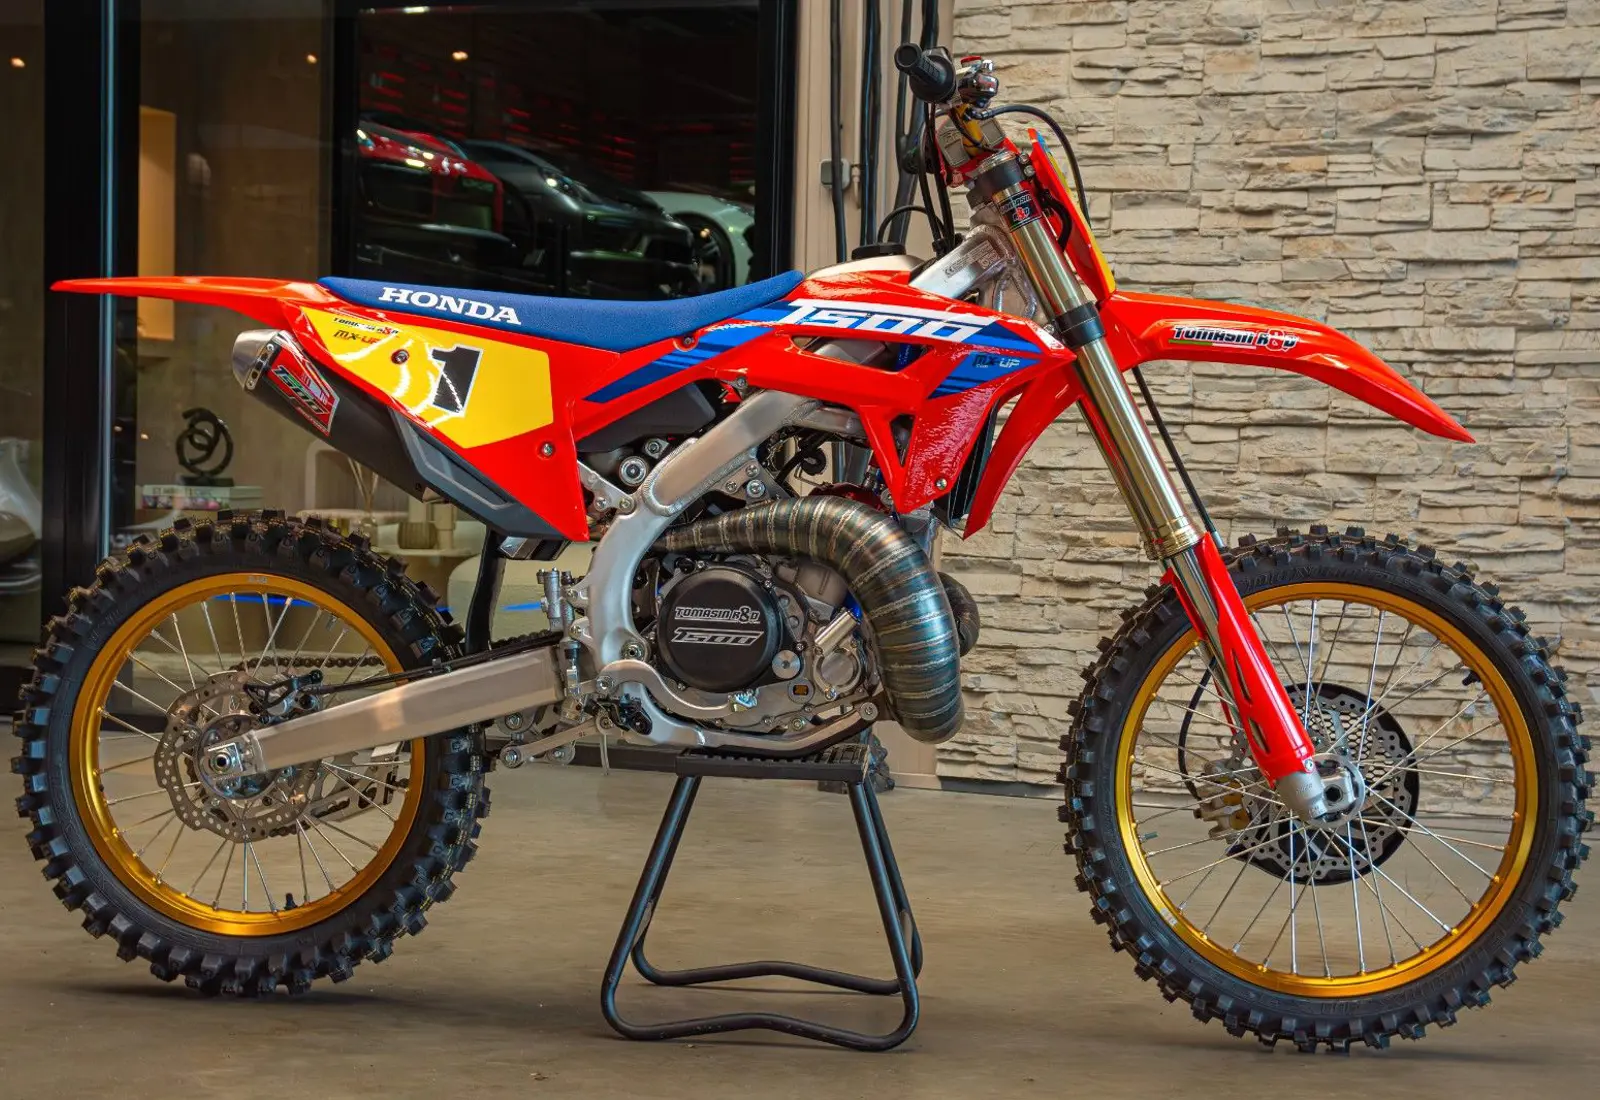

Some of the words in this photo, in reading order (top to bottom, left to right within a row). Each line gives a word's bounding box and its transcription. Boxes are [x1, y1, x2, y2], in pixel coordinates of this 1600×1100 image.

[379, 287, 521, 325] HONDA
[1172, 326, 1256, 345] TOMASIN
[1256, 328, 1299, 352] R&D
[430, 344, 483, 416] 1
[675, 606, 731, 619] TOMASIN
[731, 605, 761, 624] R&D
